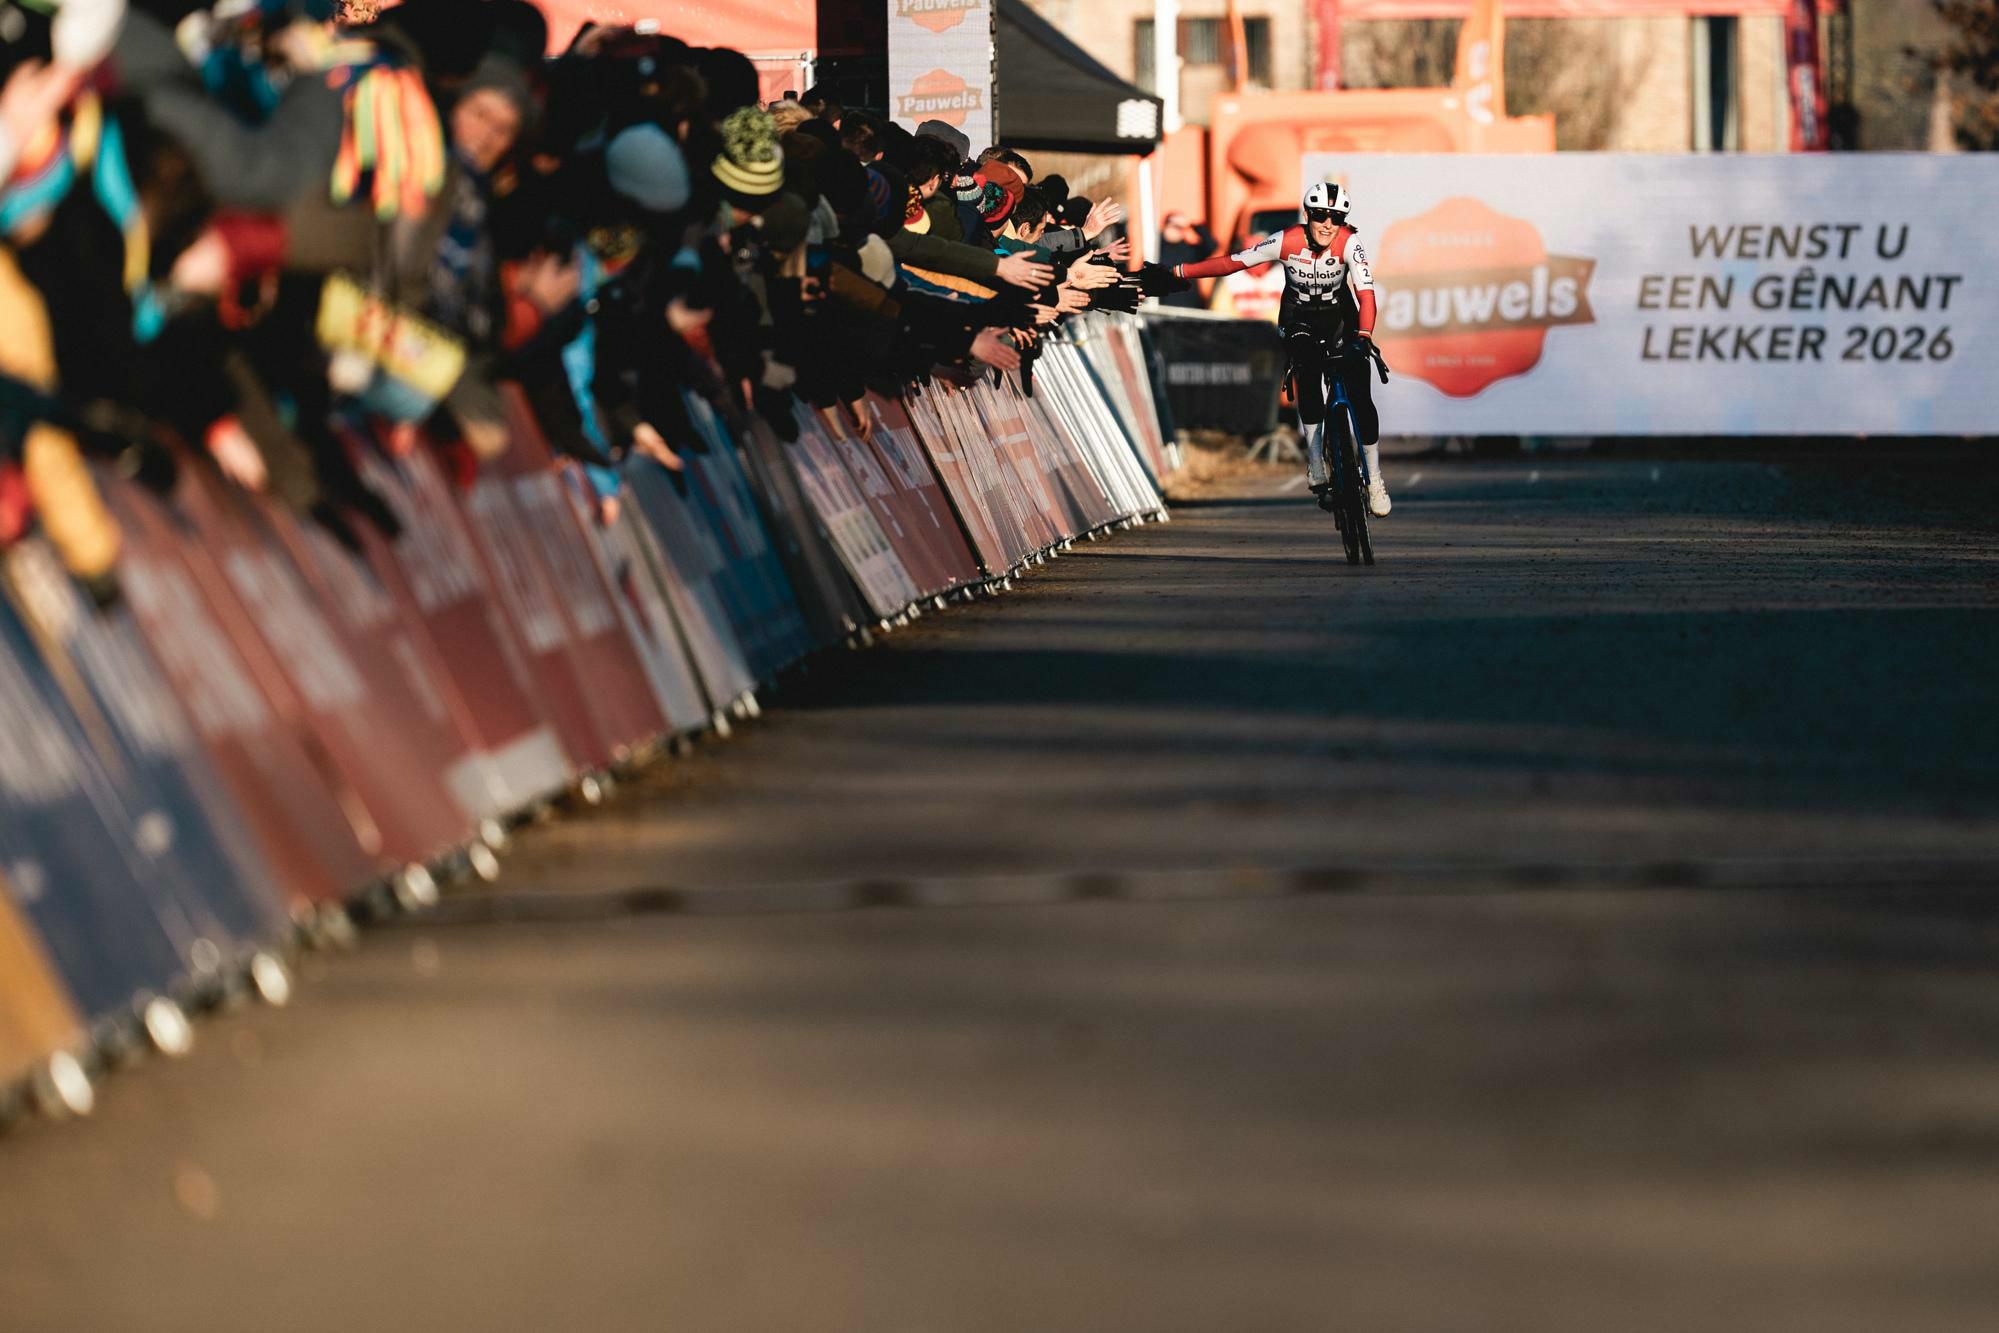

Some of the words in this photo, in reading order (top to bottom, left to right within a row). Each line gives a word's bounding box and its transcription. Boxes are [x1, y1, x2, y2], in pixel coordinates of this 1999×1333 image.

[904, 90, 977, 113] Pauwels
[1689, 223, 1862, 260] WENST
[1875, 223, 1909, 260] U
[1298, 269, 1341, 279] baloise
[1362, 268, 1370, 277] 2
[1637, 273, 1736, 311] EEN
[1751, 265, 1964, 312] GÊNANT
[1641, 326, 1828, 361] LEKKER
[1840, 325, 1955, 362] 2026
